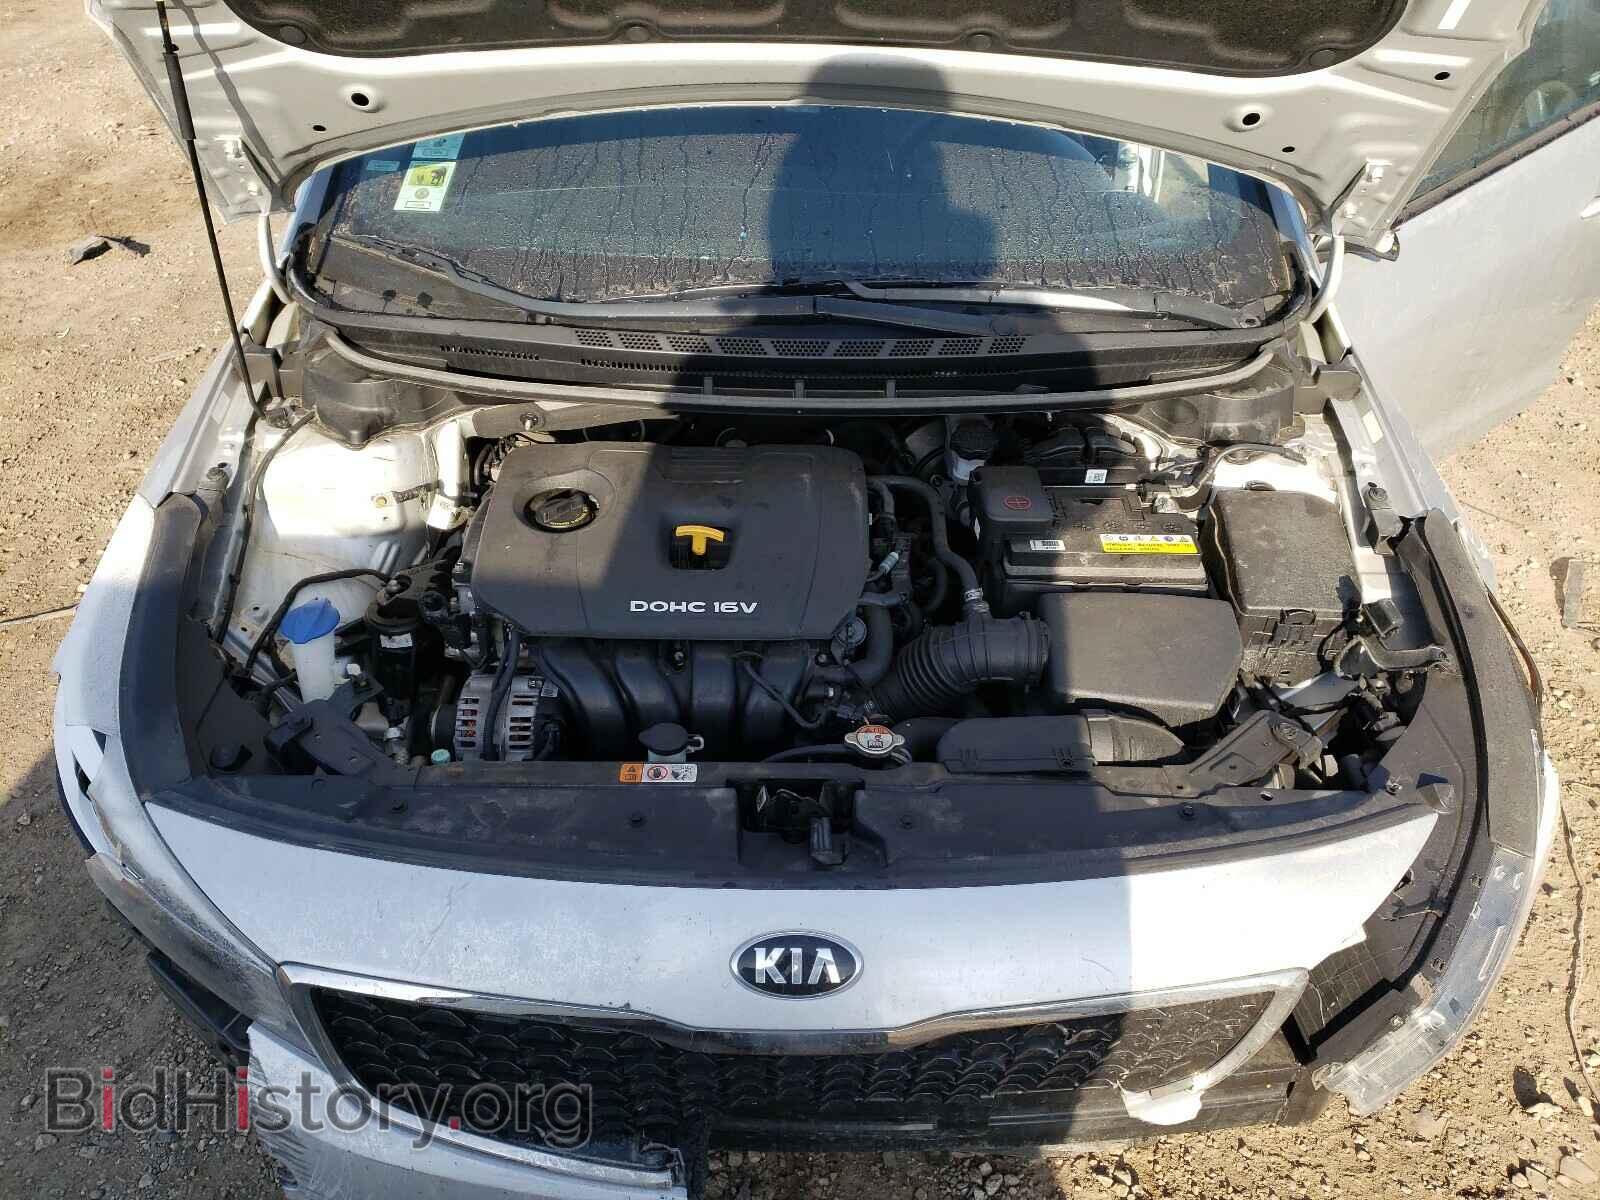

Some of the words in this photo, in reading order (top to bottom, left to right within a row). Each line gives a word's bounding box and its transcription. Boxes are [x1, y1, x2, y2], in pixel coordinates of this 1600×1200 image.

[630, 600, 706, 613] DOHC
[713, 601, 758, 614] 16V
[753, 947, 841, 985] KIA
